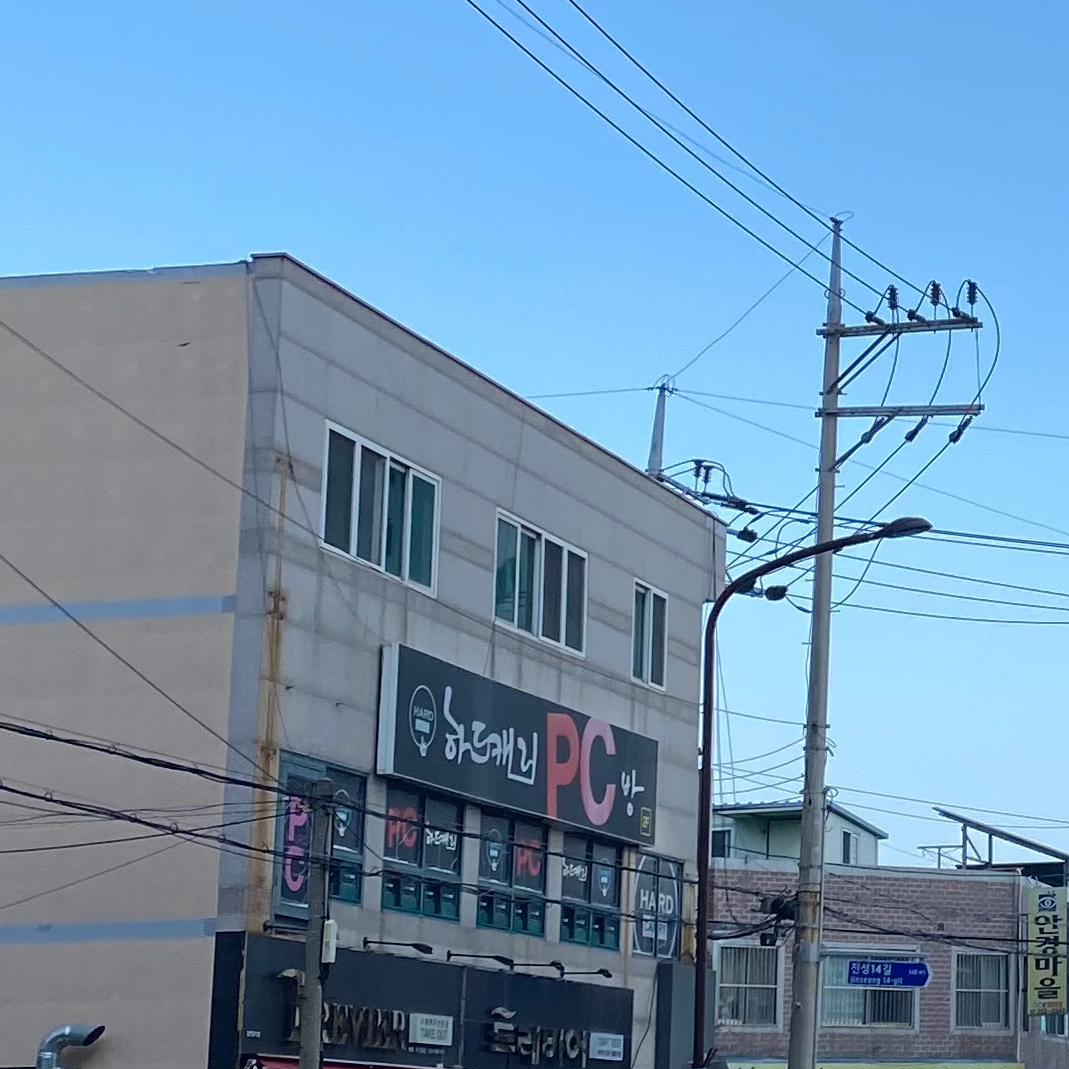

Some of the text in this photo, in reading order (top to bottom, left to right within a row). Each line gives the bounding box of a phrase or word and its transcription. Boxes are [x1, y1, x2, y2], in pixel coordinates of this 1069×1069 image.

[285, 796, 309, 892] PC
[388, 806, 418, 848] PC
[516, 838, 541, 877] PC
[640, 888, 674, 914] HARD
[1033, 914, 1064, 1000] 안경마을
